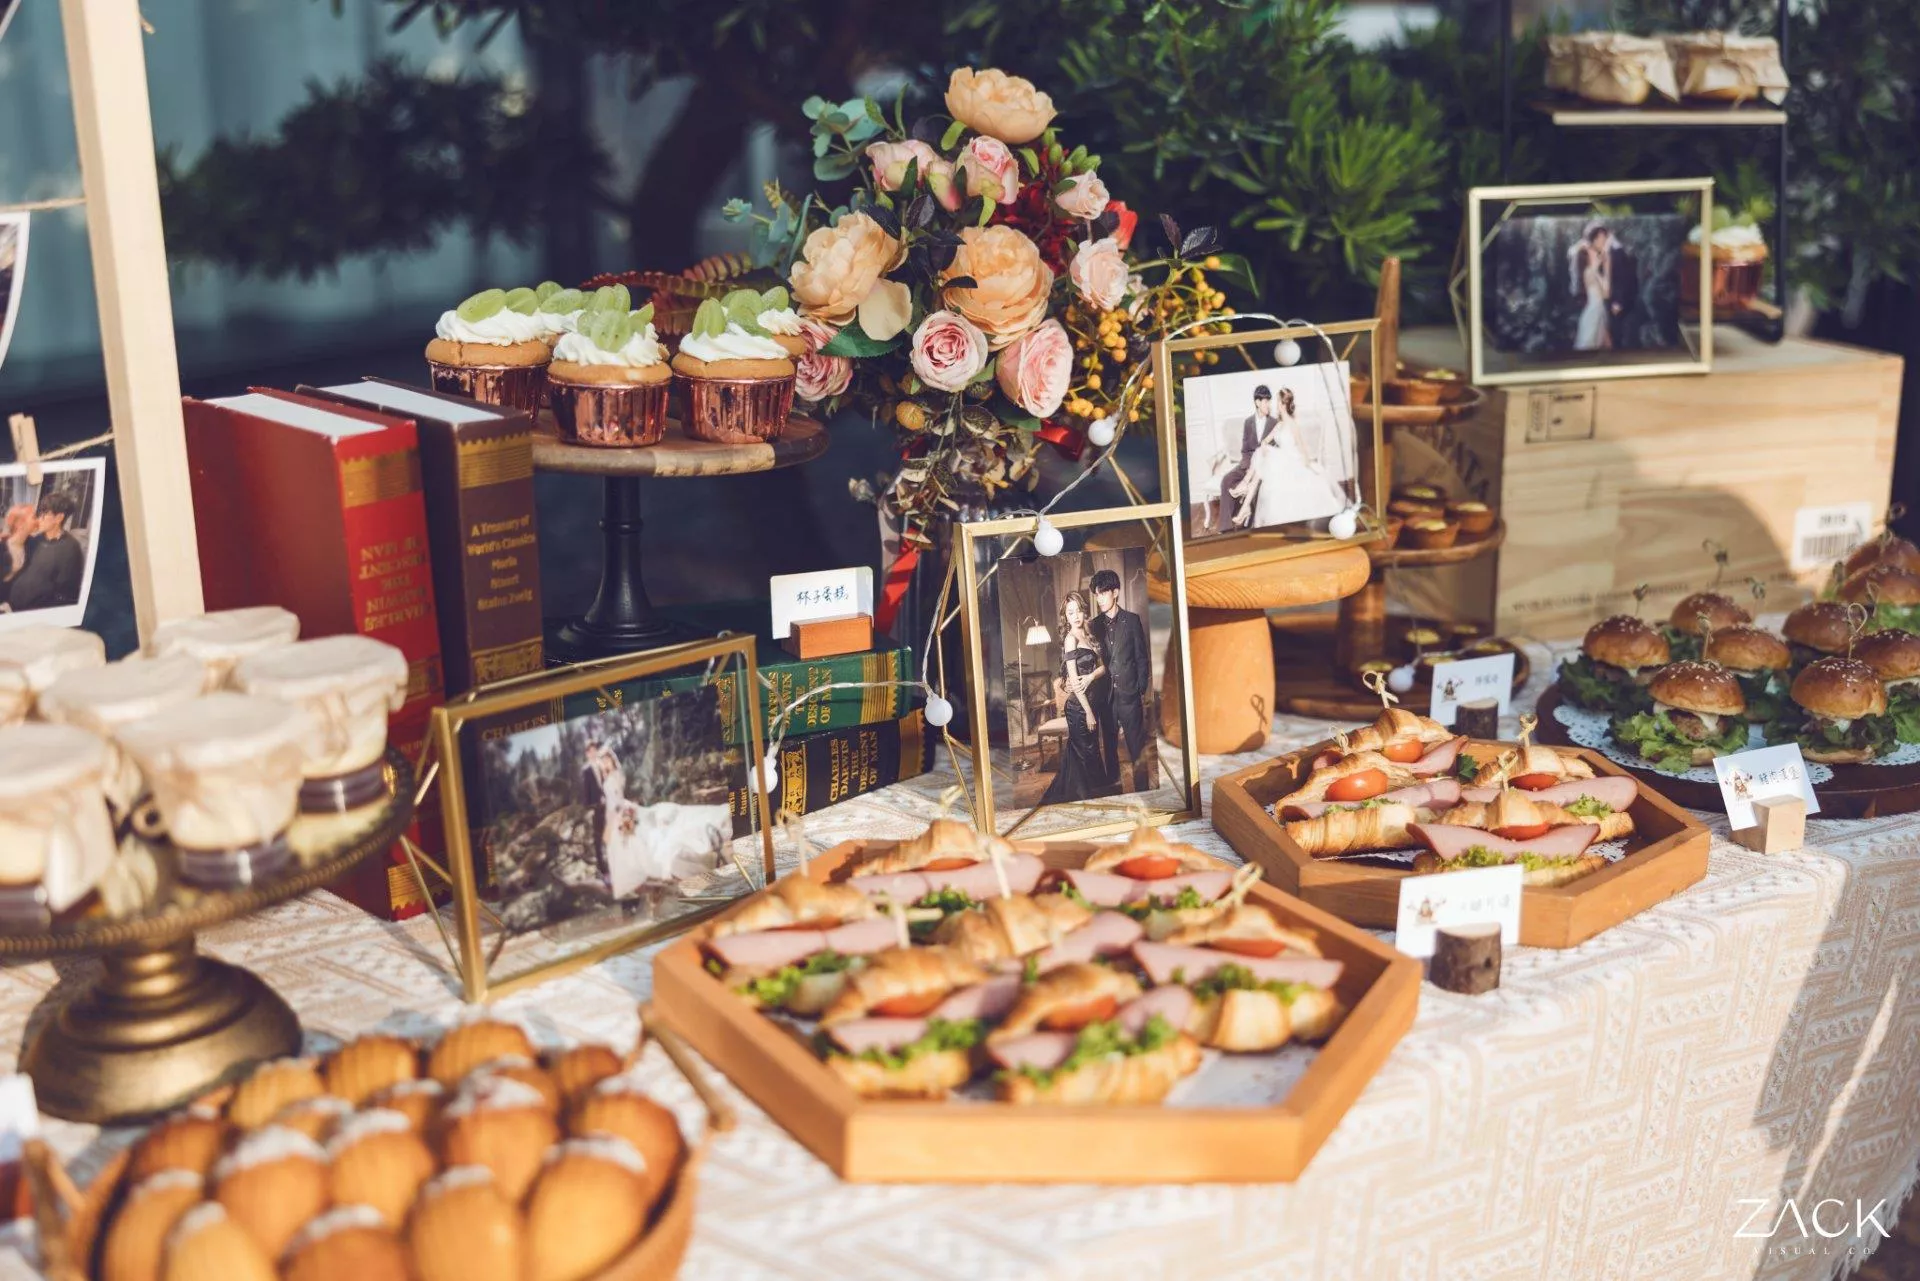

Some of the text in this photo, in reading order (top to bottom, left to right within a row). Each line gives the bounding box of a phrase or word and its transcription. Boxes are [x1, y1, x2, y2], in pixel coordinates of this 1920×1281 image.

[795, 686, 805, 715] TE
[820, 705, 831, 724] OF
[830, 738, 839, 802] CHARLES
[840, 739, 849, 796] DARWIN
[851, 750, 859, 779] THE
[859, 731, 868, 792] DESCENT
[869, 768, 878, 785] OF
[740, 785, 748, 816] Stuart
